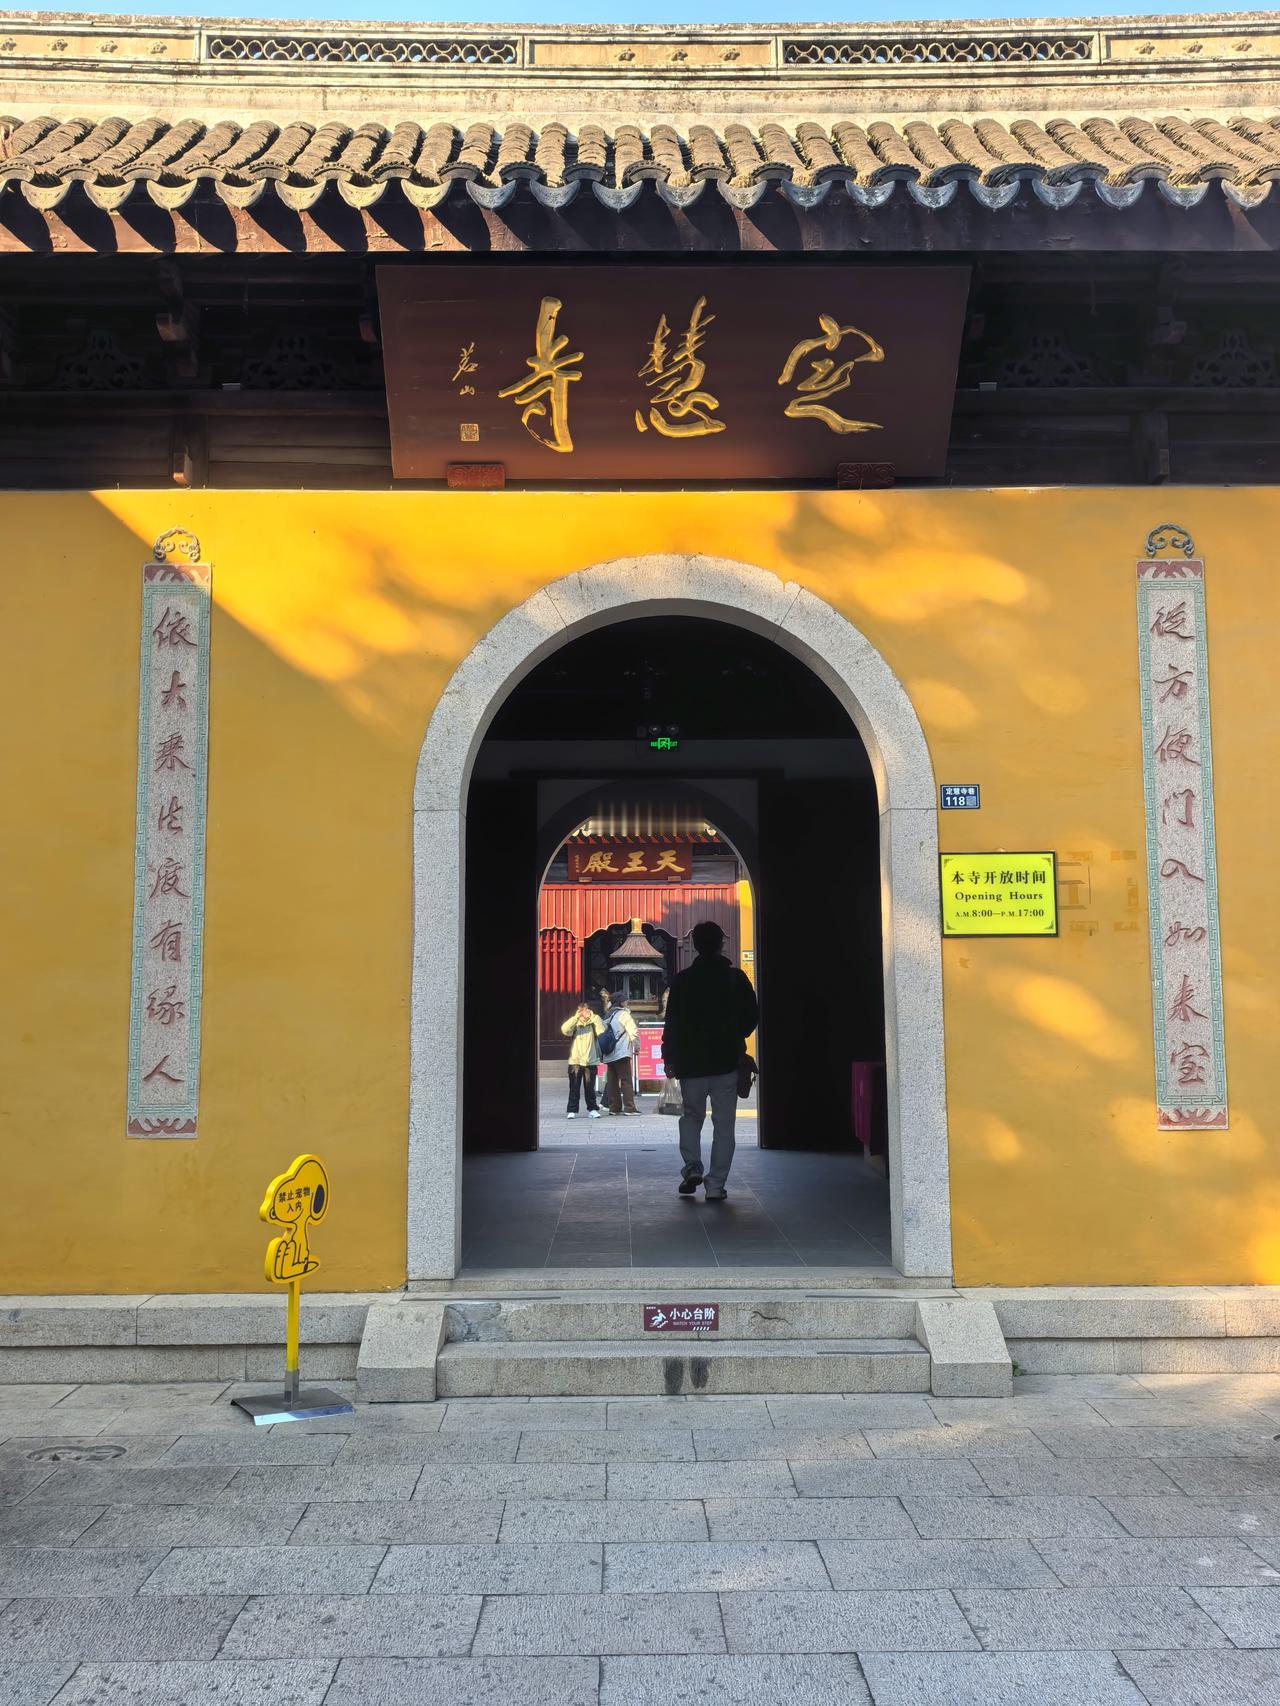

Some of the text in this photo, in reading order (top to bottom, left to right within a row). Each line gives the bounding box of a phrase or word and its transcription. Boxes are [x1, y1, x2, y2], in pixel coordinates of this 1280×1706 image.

[498, 296, 885, 453] 定慧寺
[945, 796, 966, 806] 118
[582, 850, 686, 873] 天王殿
[952, 870, 1046, 885] 本寺开放时间
[955, 891, 1043, 902] Opening Hours
[278, 1187, 310, 1203] 禁止宠物
[286, 1202, 302, 1213] 入内
[670, 1307, 715, 1320] 小心台阶
